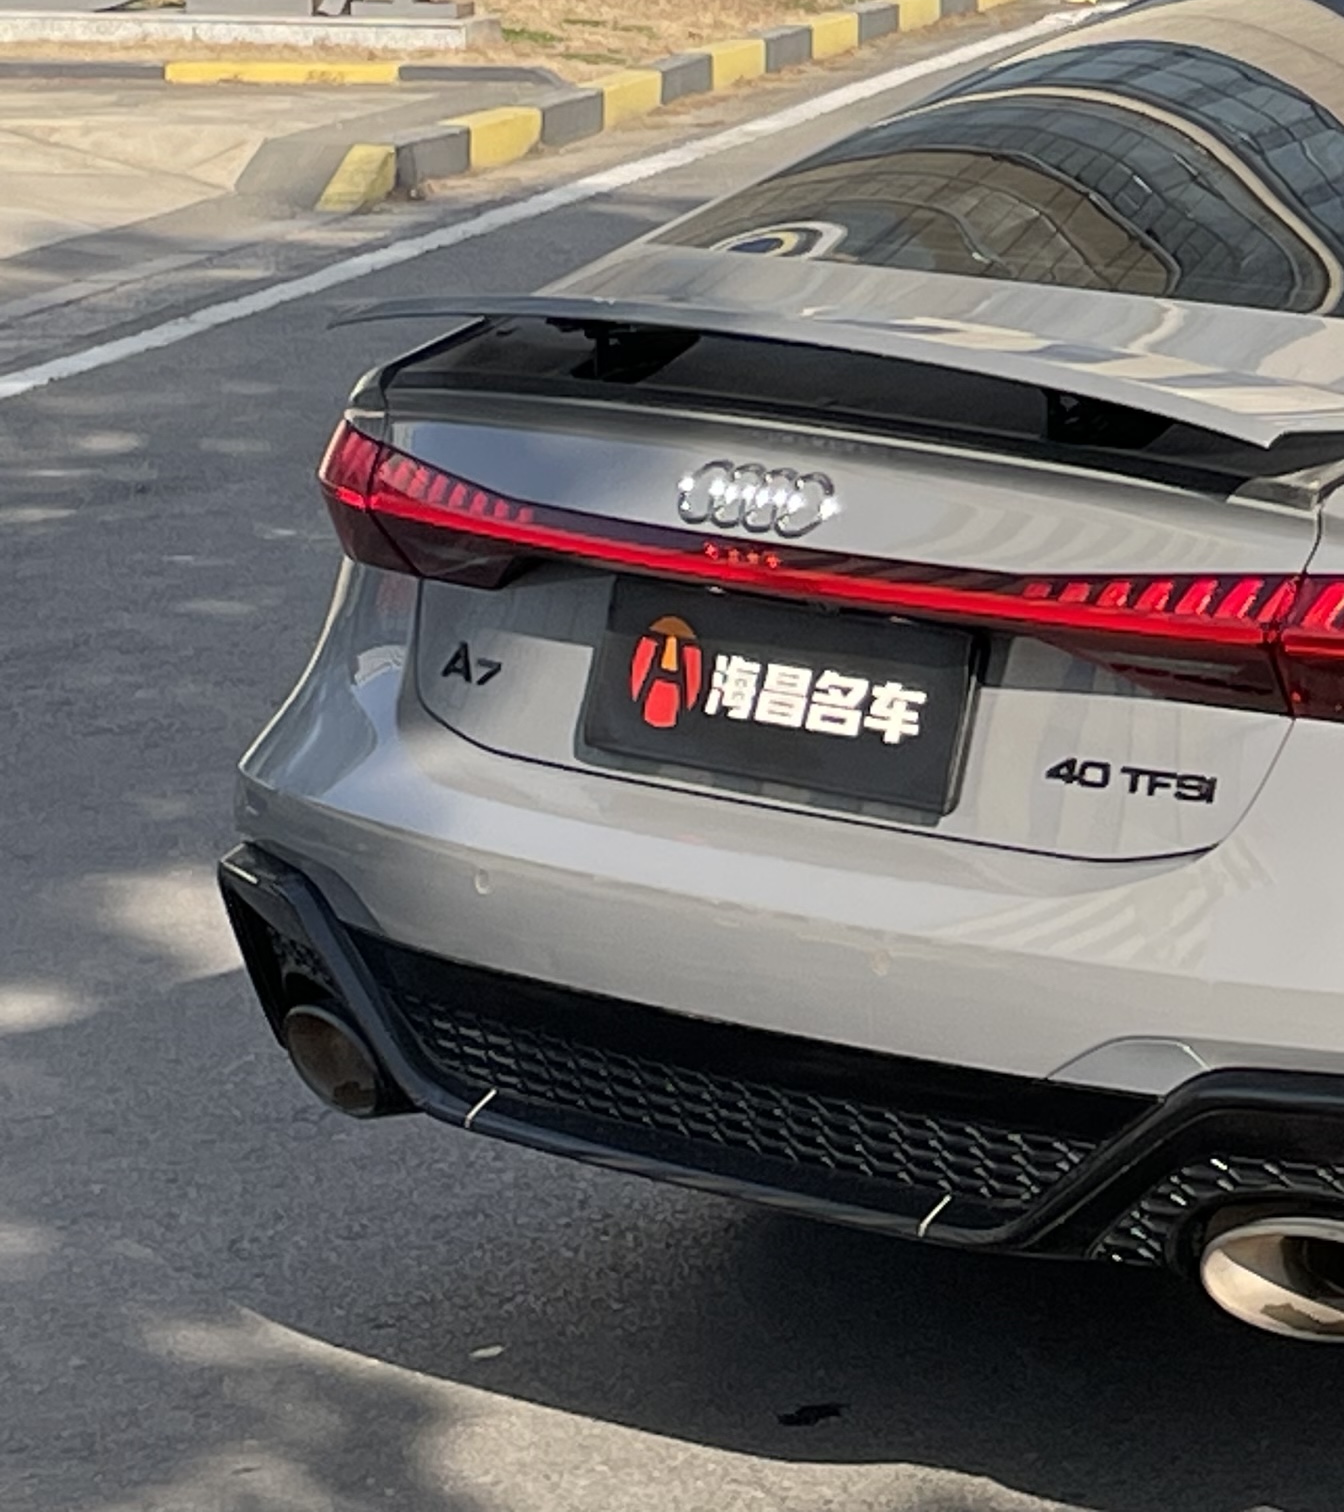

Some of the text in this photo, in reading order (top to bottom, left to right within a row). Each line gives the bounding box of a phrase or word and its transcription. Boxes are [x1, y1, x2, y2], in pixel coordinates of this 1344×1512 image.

[442, 641, 502, 685] A7
[704, 654, 928, 744] 海昌名车
[1045, 758, 1217, 804] 40 TFSI
